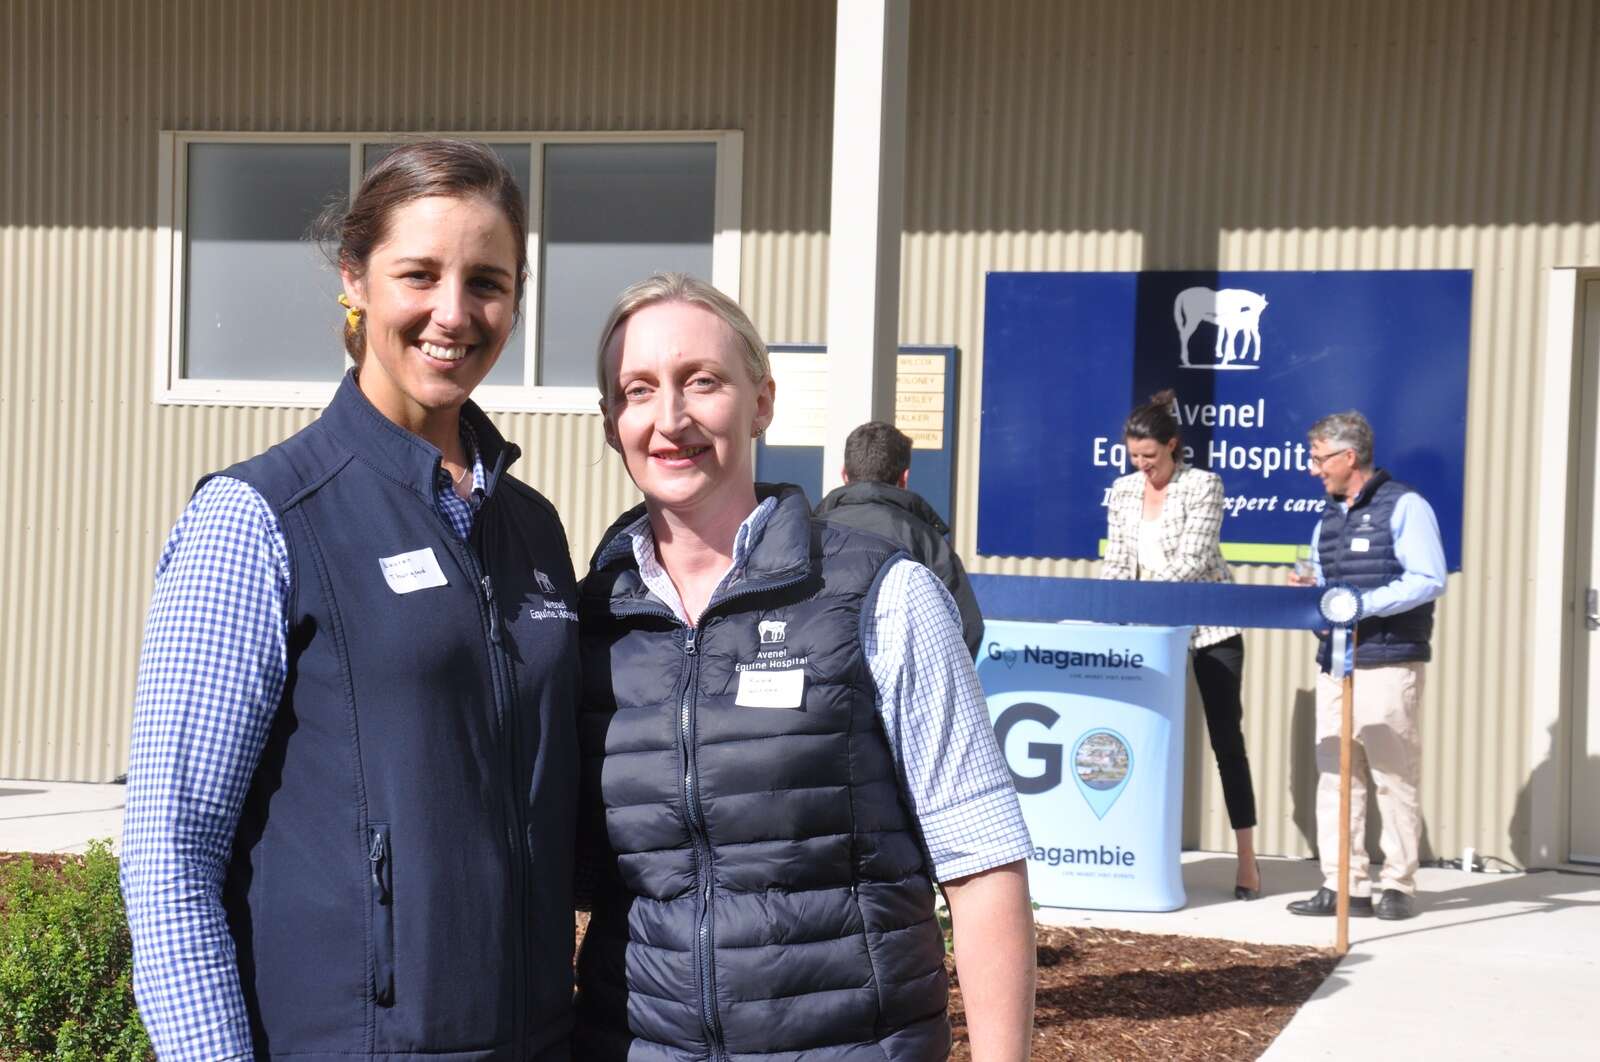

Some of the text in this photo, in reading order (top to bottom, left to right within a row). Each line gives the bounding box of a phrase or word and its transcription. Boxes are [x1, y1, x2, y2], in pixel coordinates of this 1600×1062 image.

[1169, 397, 1264, 428] Avenel
[1093, 437, 1312, 478] Eqe Hospit
[1222, 494, 1327, 517] xpert care
[529, 608, 558, 620] Equine
[735, 656, 808, 672] Equine Hospital
[757, 648, 787, 659] Avenel
[1023, 644, 1144, 670] Nagambie
[1027, 845, 1135, 867] agambie
